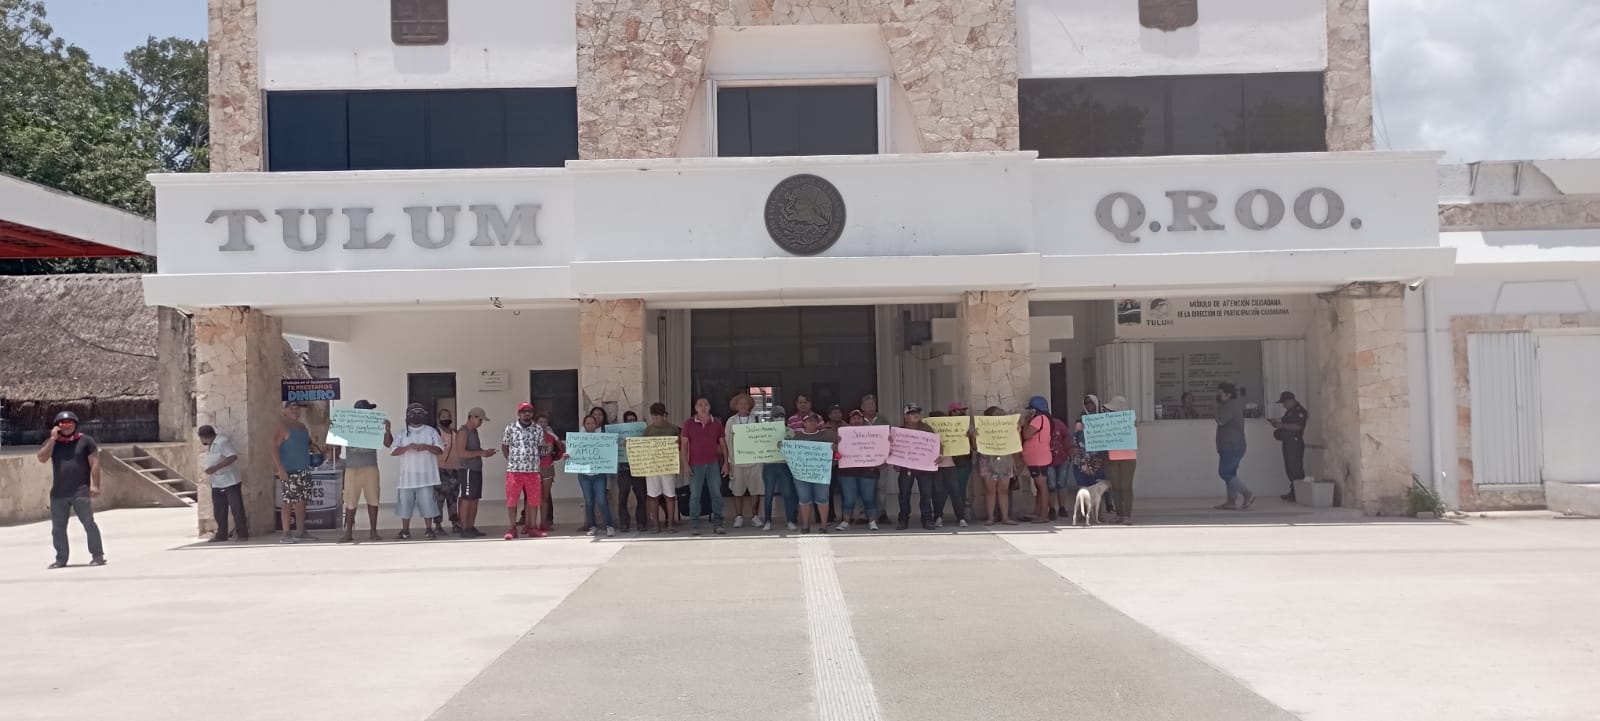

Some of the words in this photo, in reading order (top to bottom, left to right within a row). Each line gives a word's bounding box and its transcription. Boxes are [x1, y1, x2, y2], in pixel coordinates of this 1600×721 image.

[205, 204, 542, 252] TULUM
[1189, 299, 1212, 308] MÓDULO
[1223, 298, 1250, 307] ATENCIÓN
[288, 390, 335, 400] DINERO
[575, 448, 600, 456] AMLO
